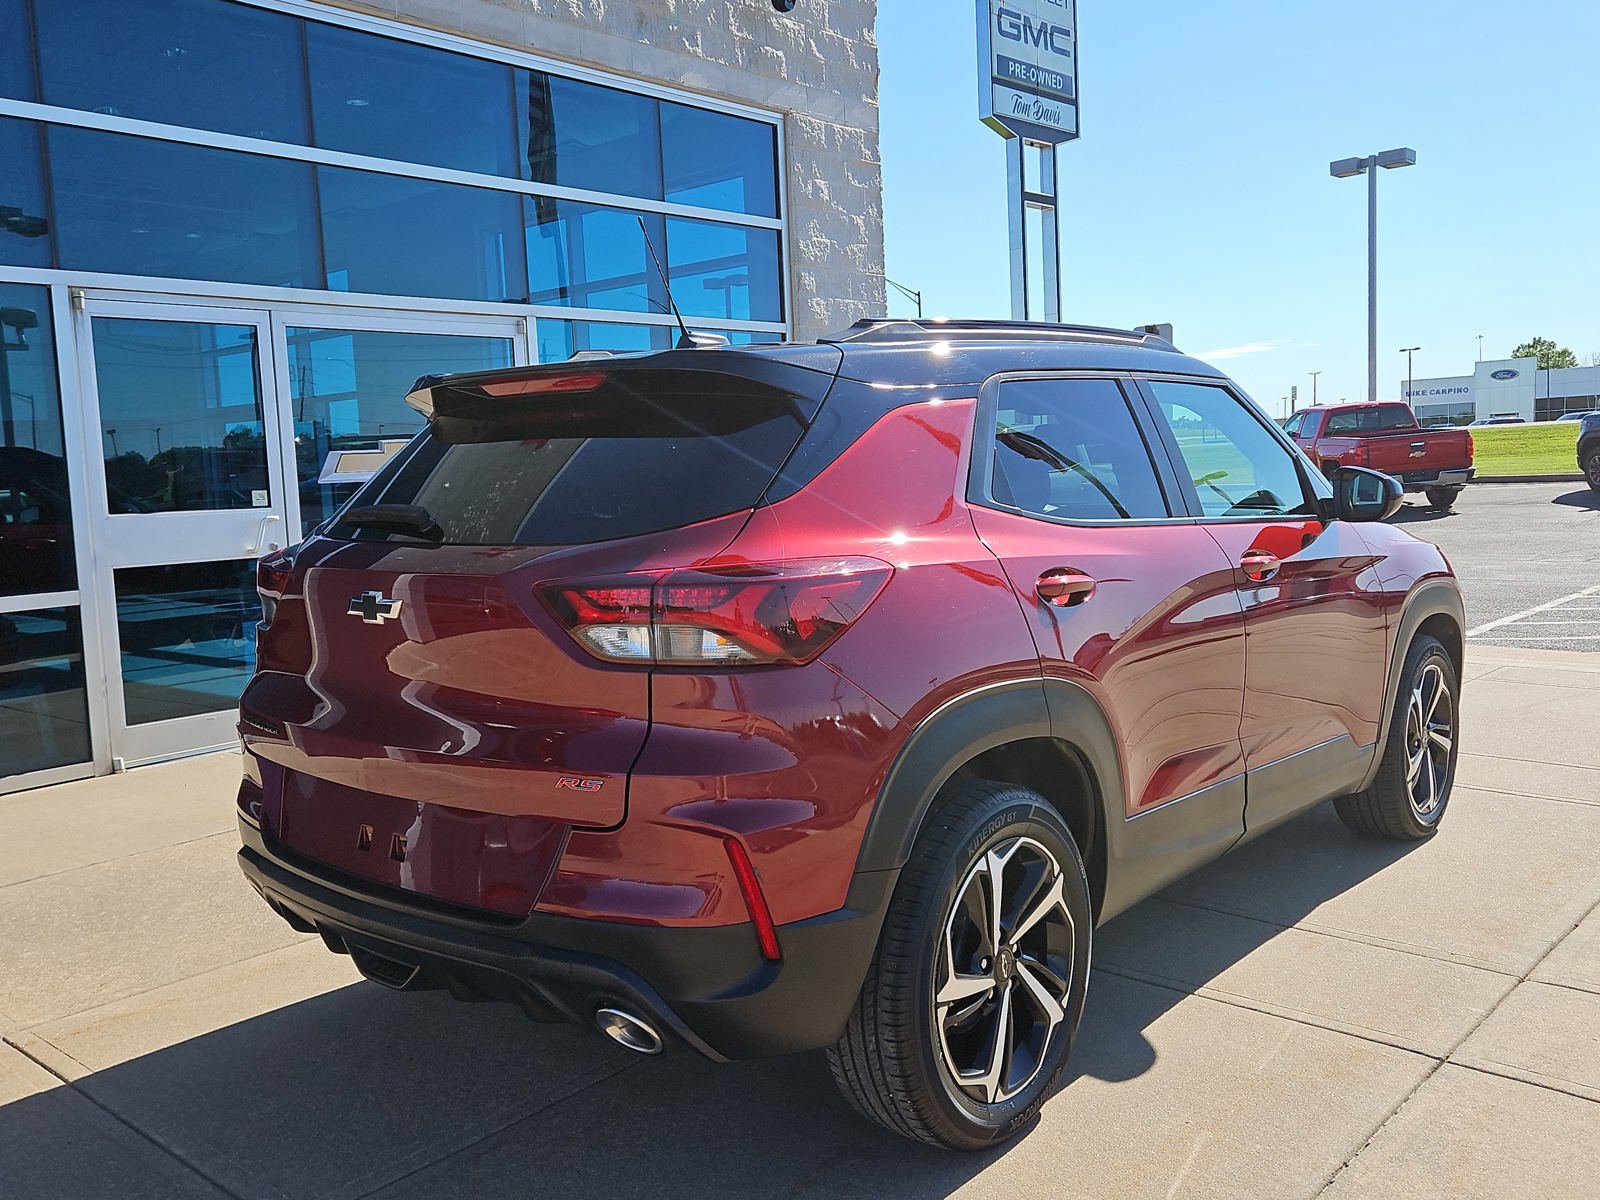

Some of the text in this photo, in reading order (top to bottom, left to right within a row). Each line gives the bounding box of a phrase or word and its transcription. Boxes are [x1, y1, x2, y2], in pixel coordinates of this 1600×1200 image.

[997, 7, 1070, 57] GMC
[1009, 61, 1063, 89] PRE-OWNED
[1011, 94, 1061, 125] Tom Davis
[1429, 387, 1469, 395] CARPINO
[555, 777, 604, 791] RS
